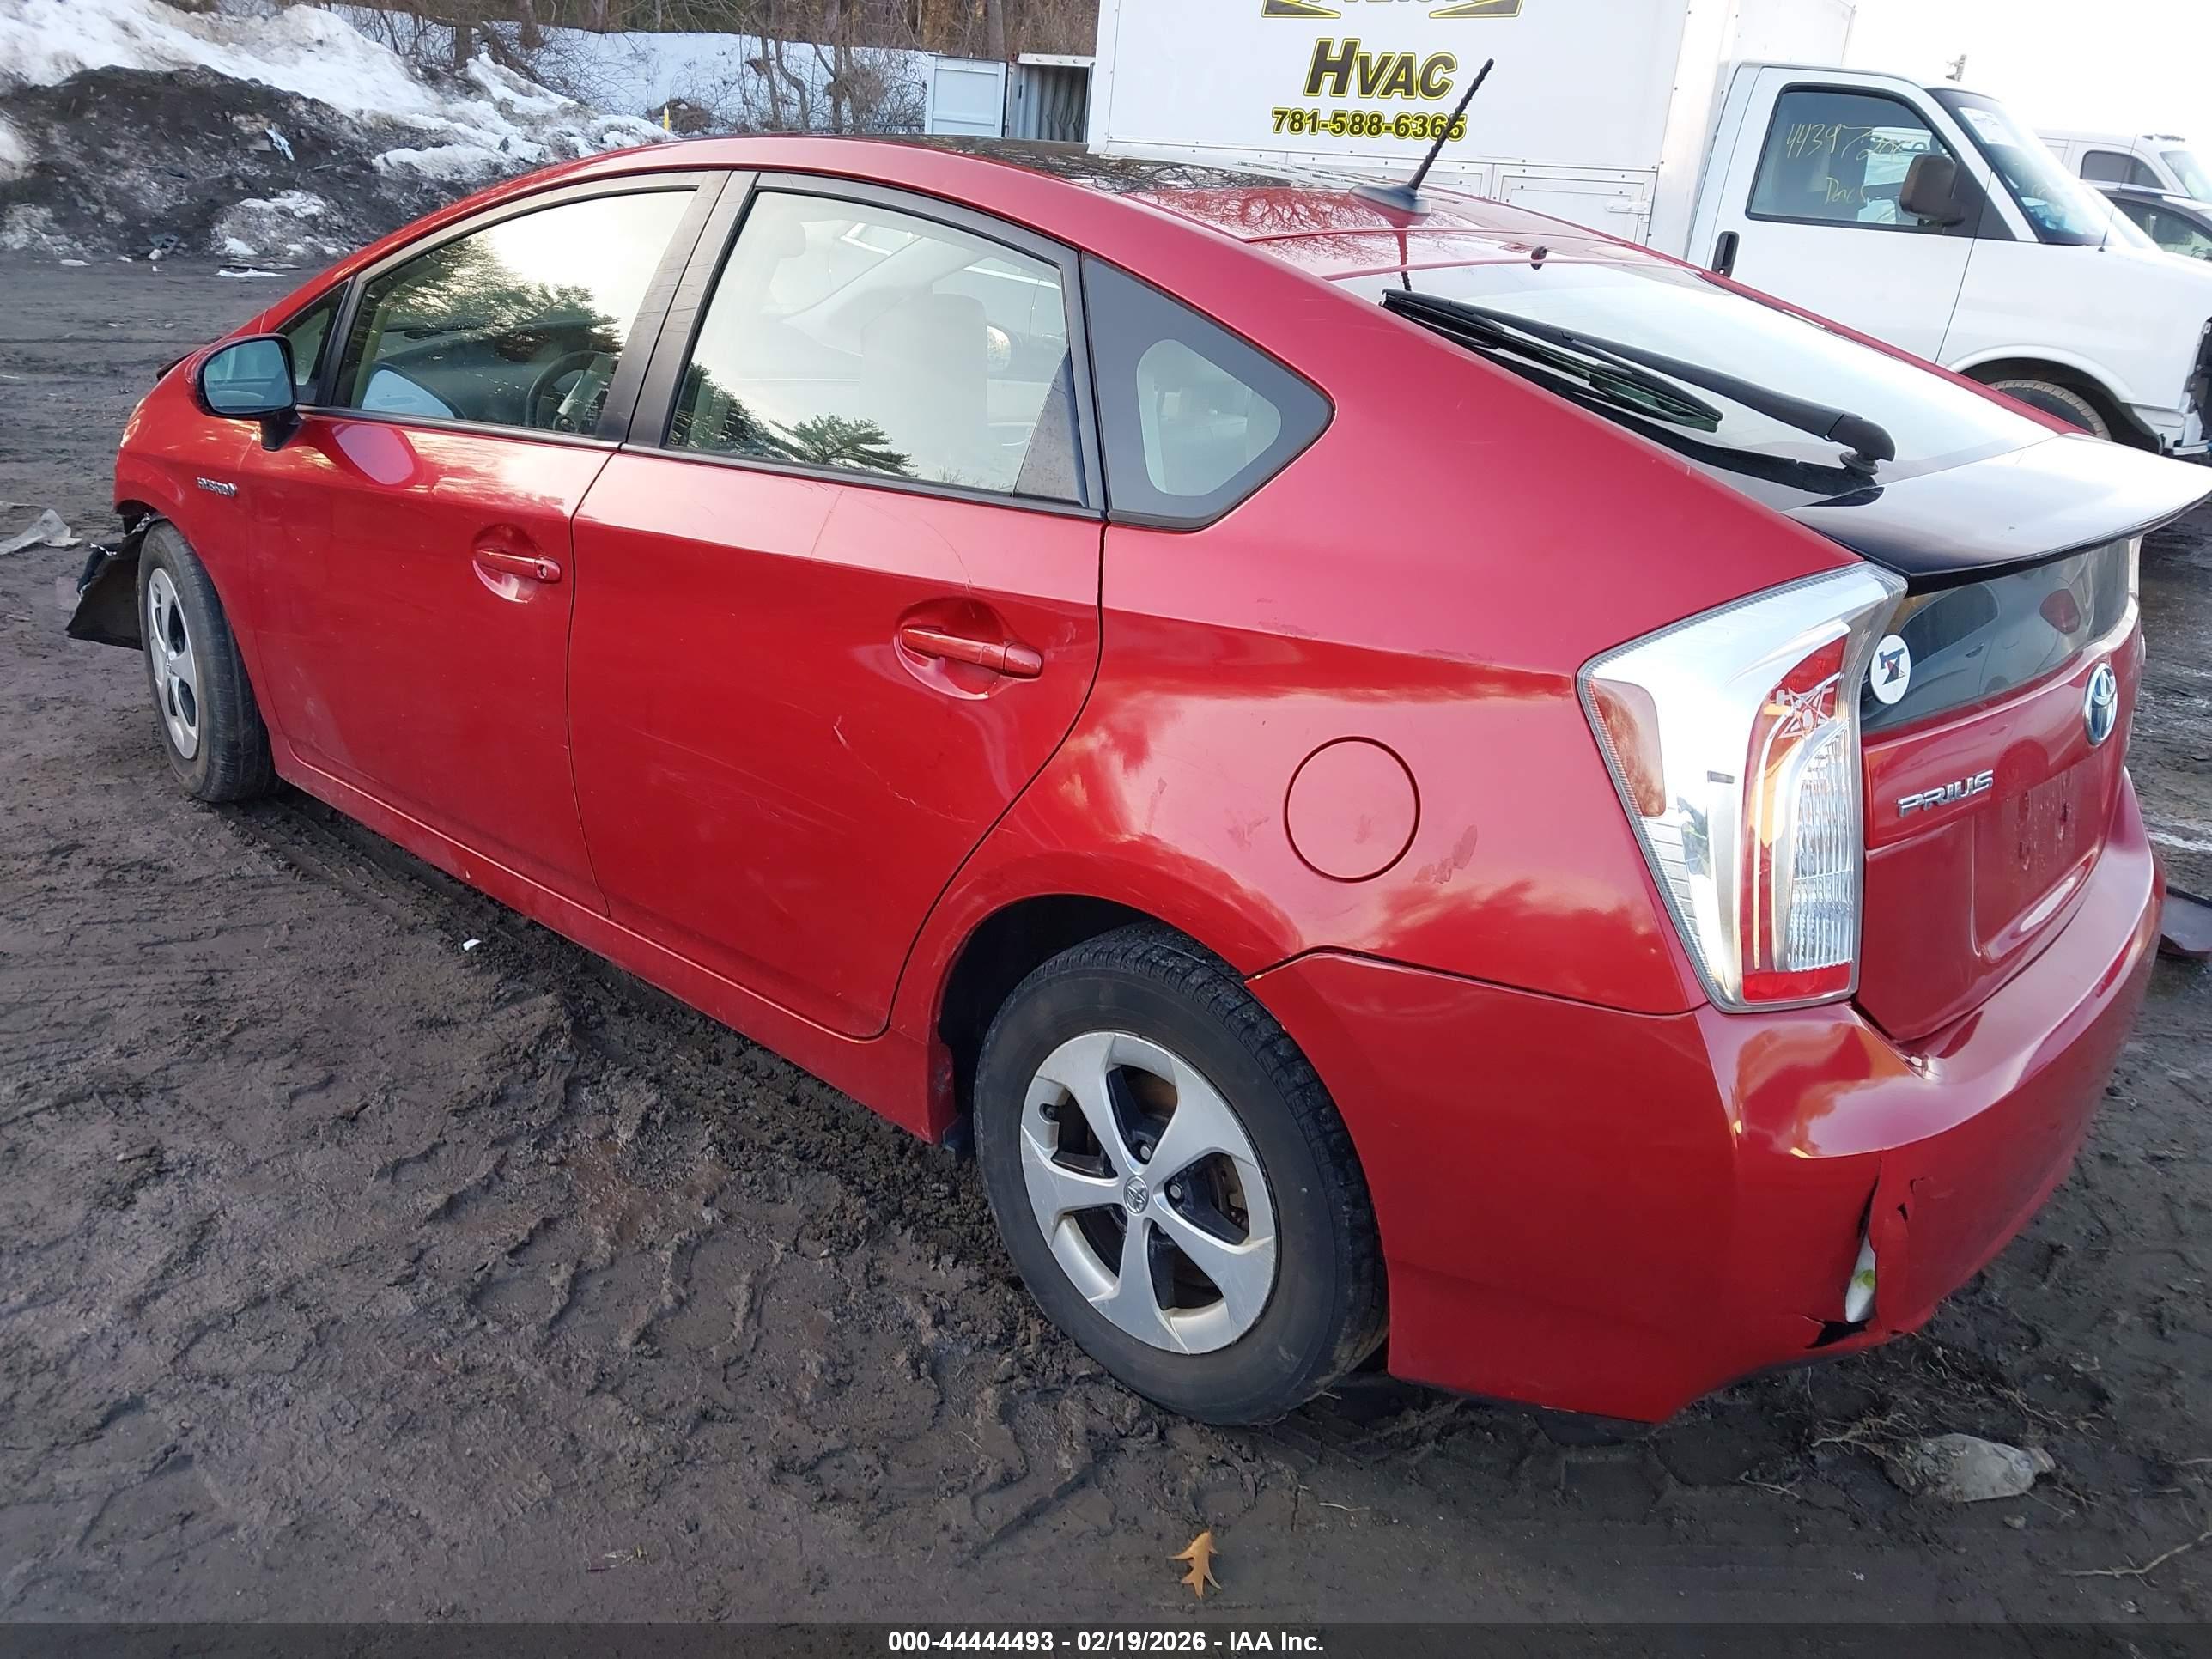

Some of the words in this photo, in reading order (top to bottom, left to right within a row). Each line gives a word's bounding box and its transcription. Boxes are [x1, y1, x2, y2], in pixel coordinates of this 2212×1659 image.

[1304, 38, 1457, 100] HVAC
[1272, 107, 1468, 141] 781-588-6365
[1896, 769, 1994, 818] PRIUS
